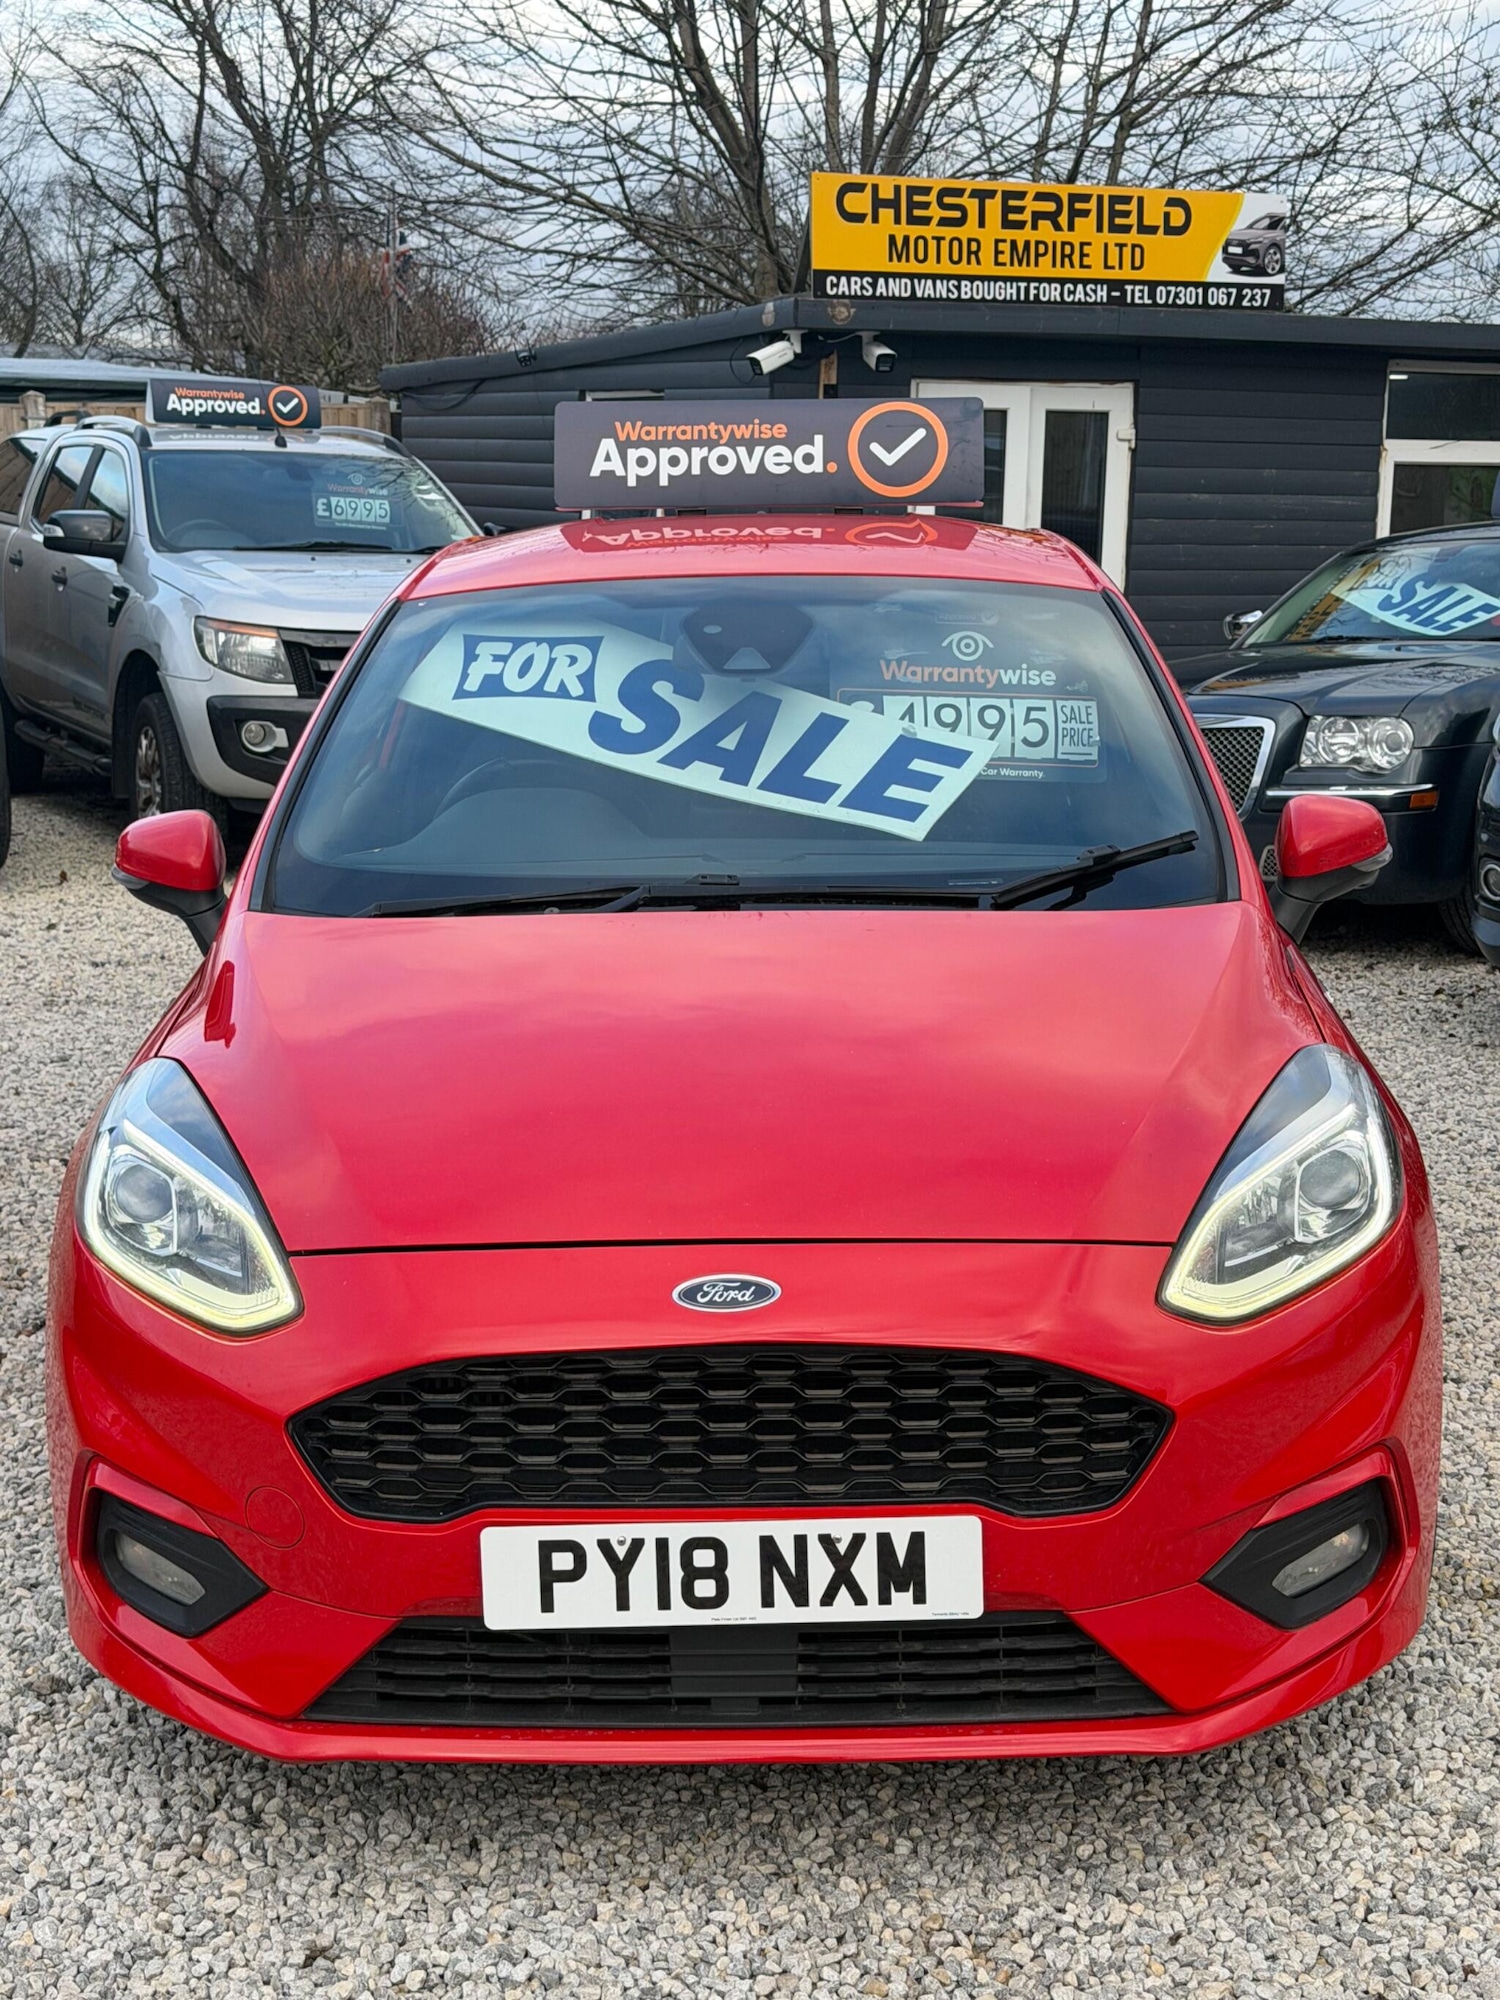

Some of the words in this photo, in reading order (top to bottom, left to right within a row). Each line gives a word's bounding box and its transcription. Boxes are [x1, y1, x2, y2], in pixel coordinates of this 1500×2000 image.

[835, 181, 1192, 236] CHESTERFIELD
[887, 233, 982, 266] MOTOR
[993, 238, 1092, 270] EMPIRE
[1103, 241, 1146, 272] LTD
[826, 275, 873, 297] CARS
[876, 277, 912, 298] AND
[914, 278, 959, 300] VANS
[961, 280, 1028, 302] BOUGHT
[1029, 282, 1062, 303] FOR
[1063, 283, 1107, 304] CASH
[1124, 285, 1153, 305] TEL
[1156, 286, 1203, 307] 07301
[1207, 287, 1237, 307] 067
[1241, 288, 1271, 308] 237
[166, 393, 266, 417] Approved.
[174, 387, 245, 400] Warrantywise
[614, 418, 788, 444] Warrantywise
[589, 434, 838, 487] Approved.
[316, 497, 389, 519] £6995
[1377, 571, 1500, 632] SALE
[463, 640, 593, 698] FOR
[880, 659, 1057, 689] Warrantywise
[850, 700, 1050, 748] 4995
[1060, 704, 1093, 725] SALE
[588, 659, 974, 824] SALE
[1060, 727, 1094, 748] PRICE
[980, 766, 998, 776] Car
[696, 1281, 756, 1304] Ford
[538, 1535, 729, 1613] PY18
[758, 1531, 927, 1609] NXM
